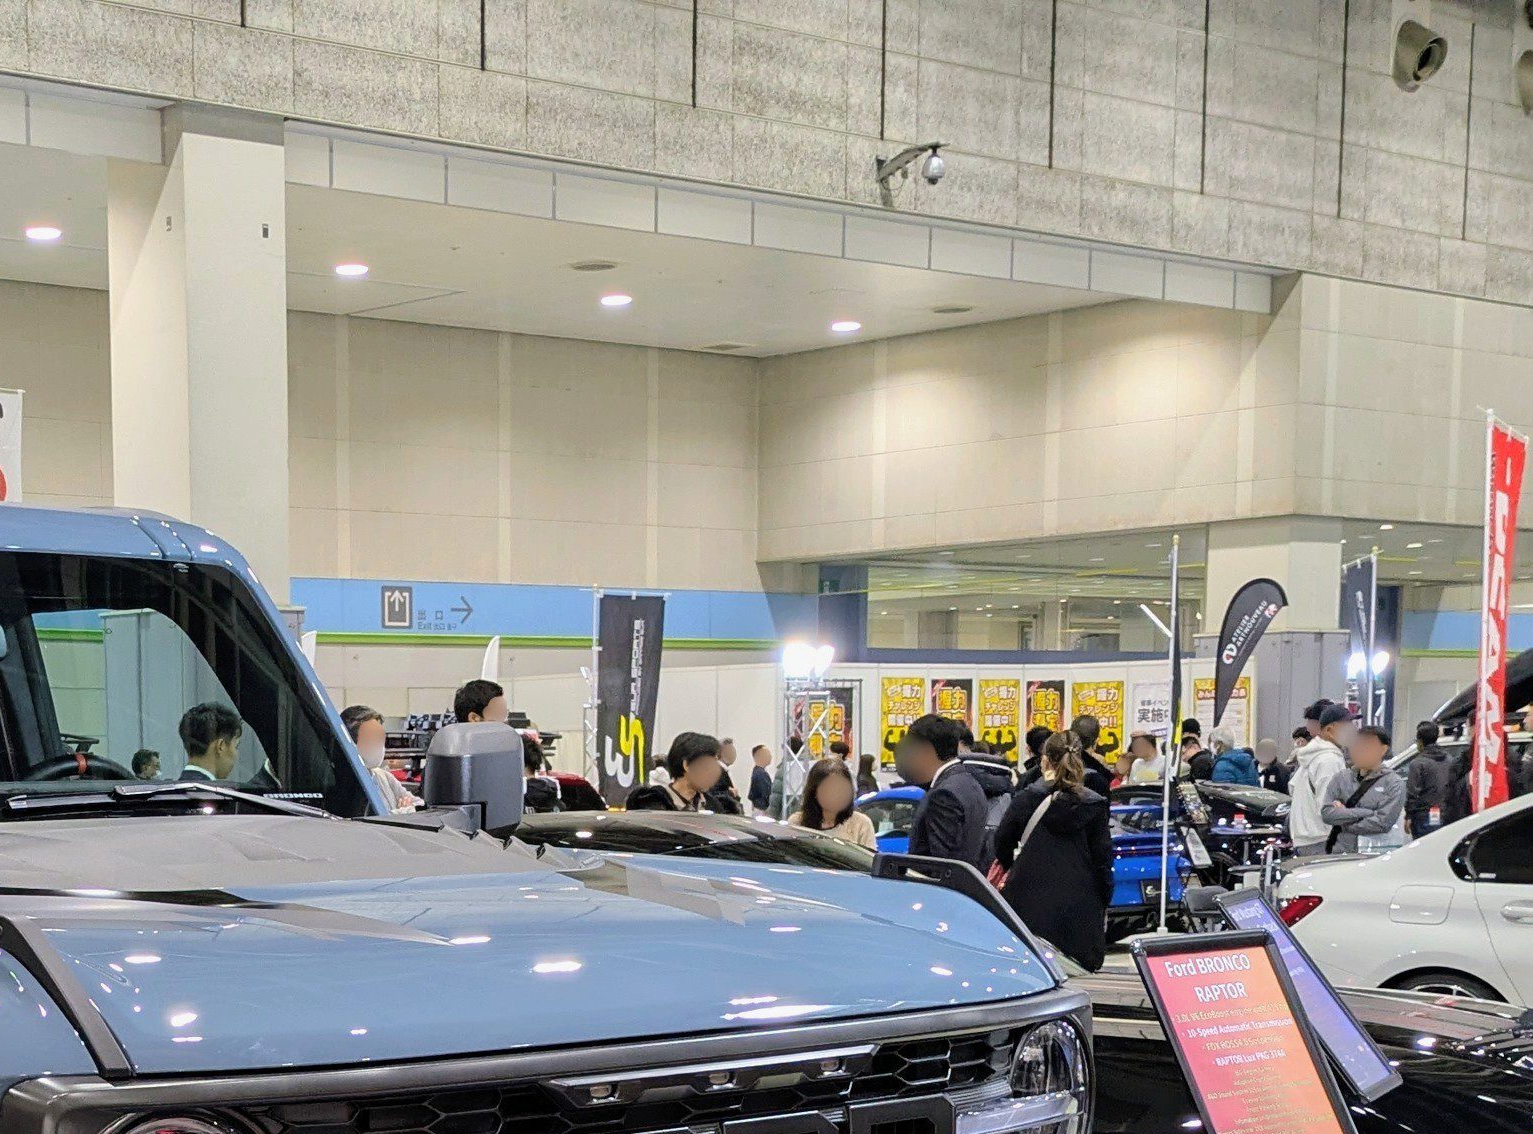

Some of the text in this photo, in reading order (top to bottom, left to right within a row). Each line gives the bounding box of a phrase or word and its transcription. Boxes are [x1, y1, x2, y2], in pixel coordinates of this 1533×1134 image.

[1164, 953, 1251, 978] Ford BRONCO
[1194, 981, 1248, 1003] RAPTOR
[1187, 1017, 1293, 1038] 10-Speed Automatic Transmission
[1215, 1054, 1243, 1067] RAPTOR
